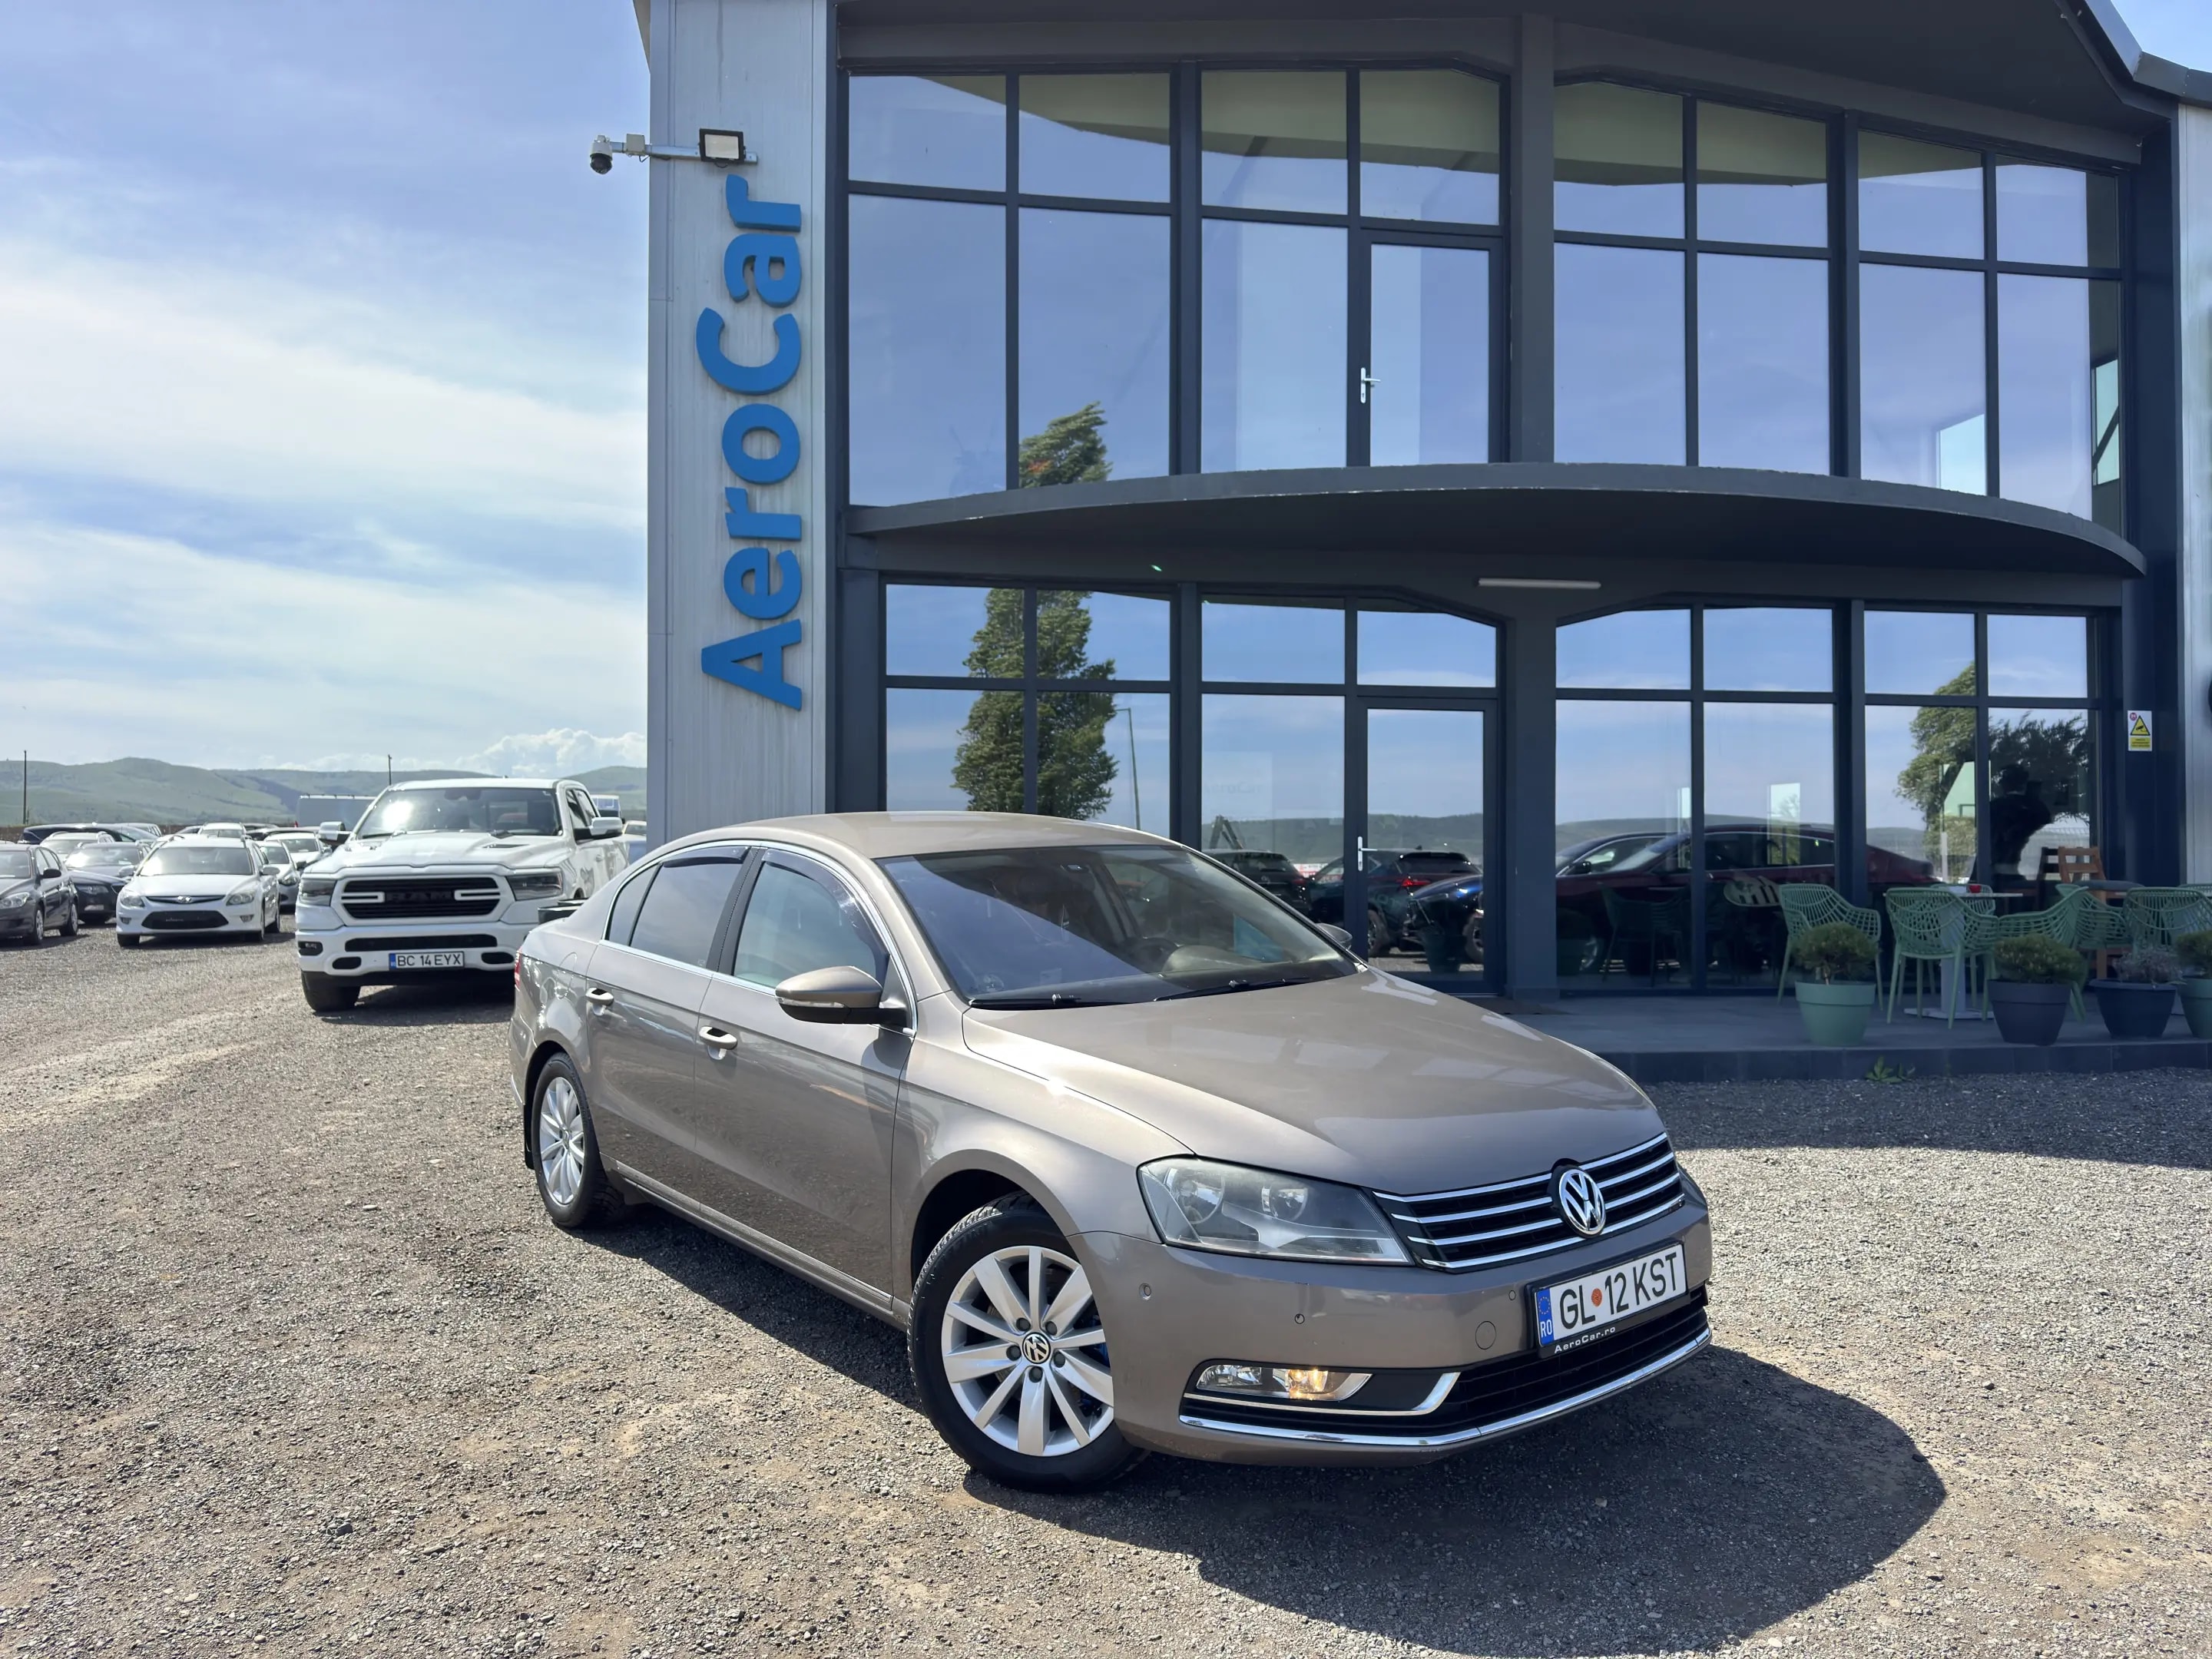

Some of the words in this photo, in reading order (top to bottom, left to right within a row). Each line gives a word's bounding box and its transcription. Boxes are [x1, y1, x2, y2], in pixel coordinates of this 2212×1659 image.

[696, 174, 802, 711] AeroCar
[397, 955, 416, 967] BC
[420, 955, 432, 966] 14
[434, 953, 461, 966] EYX
[1560, 1285, 1596, 1330] GL
[1604, 1272, 1629, 1316] 12
[1633, 1252, 1677, 1306] KST
[1540, 1319, 1553, 1338] RO
[1554, 1326, 1616, 1354] AeroCar.ro
